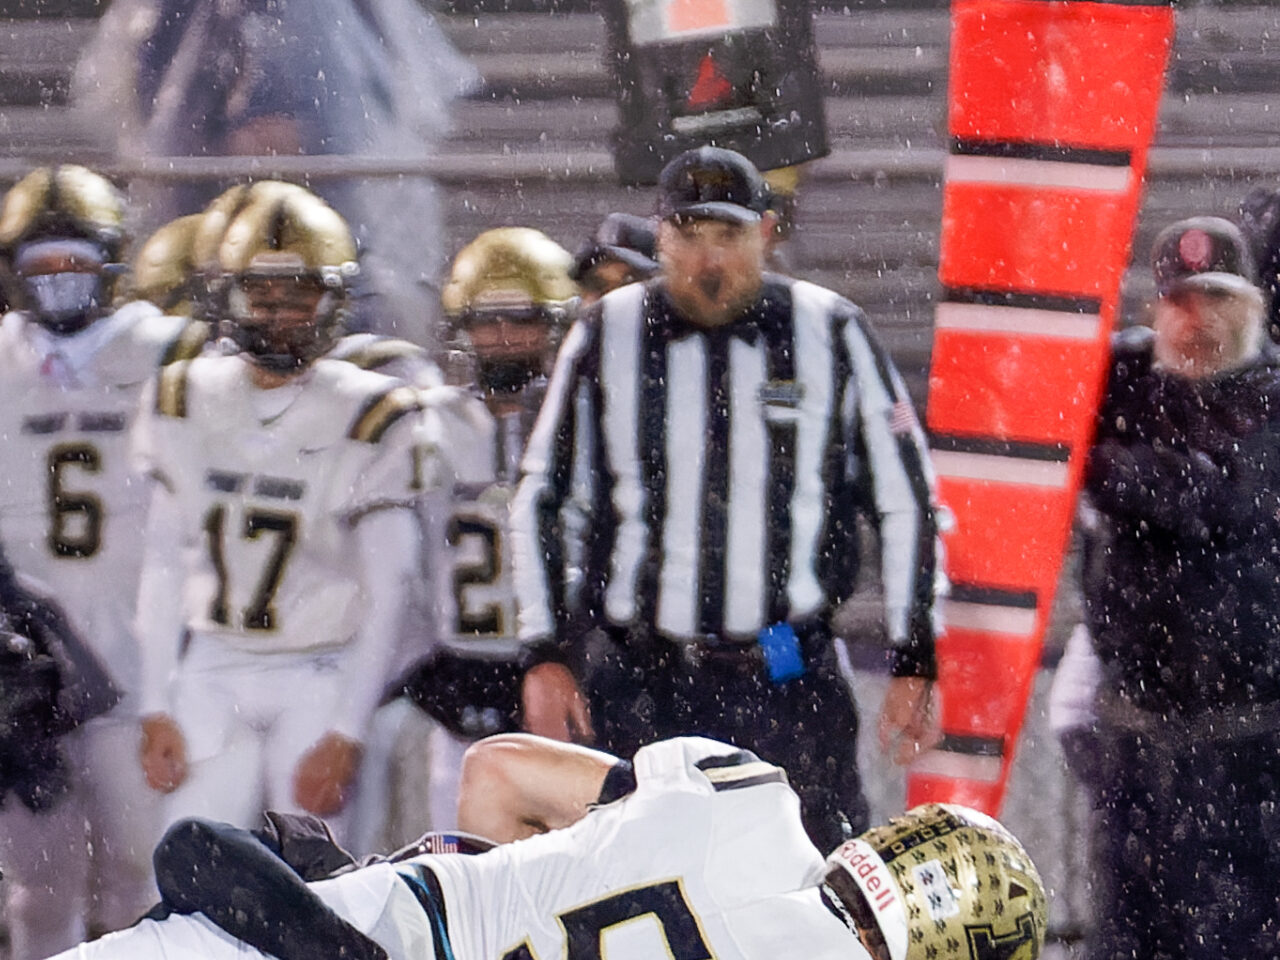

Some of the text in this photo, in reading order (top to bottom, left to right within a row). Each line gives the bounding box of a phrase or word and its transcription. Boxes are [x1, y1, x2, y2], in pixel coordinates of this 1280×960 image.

[47, 441, 102, 558] 6
[206, 502, 298, 631] 17
[837, 840, 897, 913] Riddell
